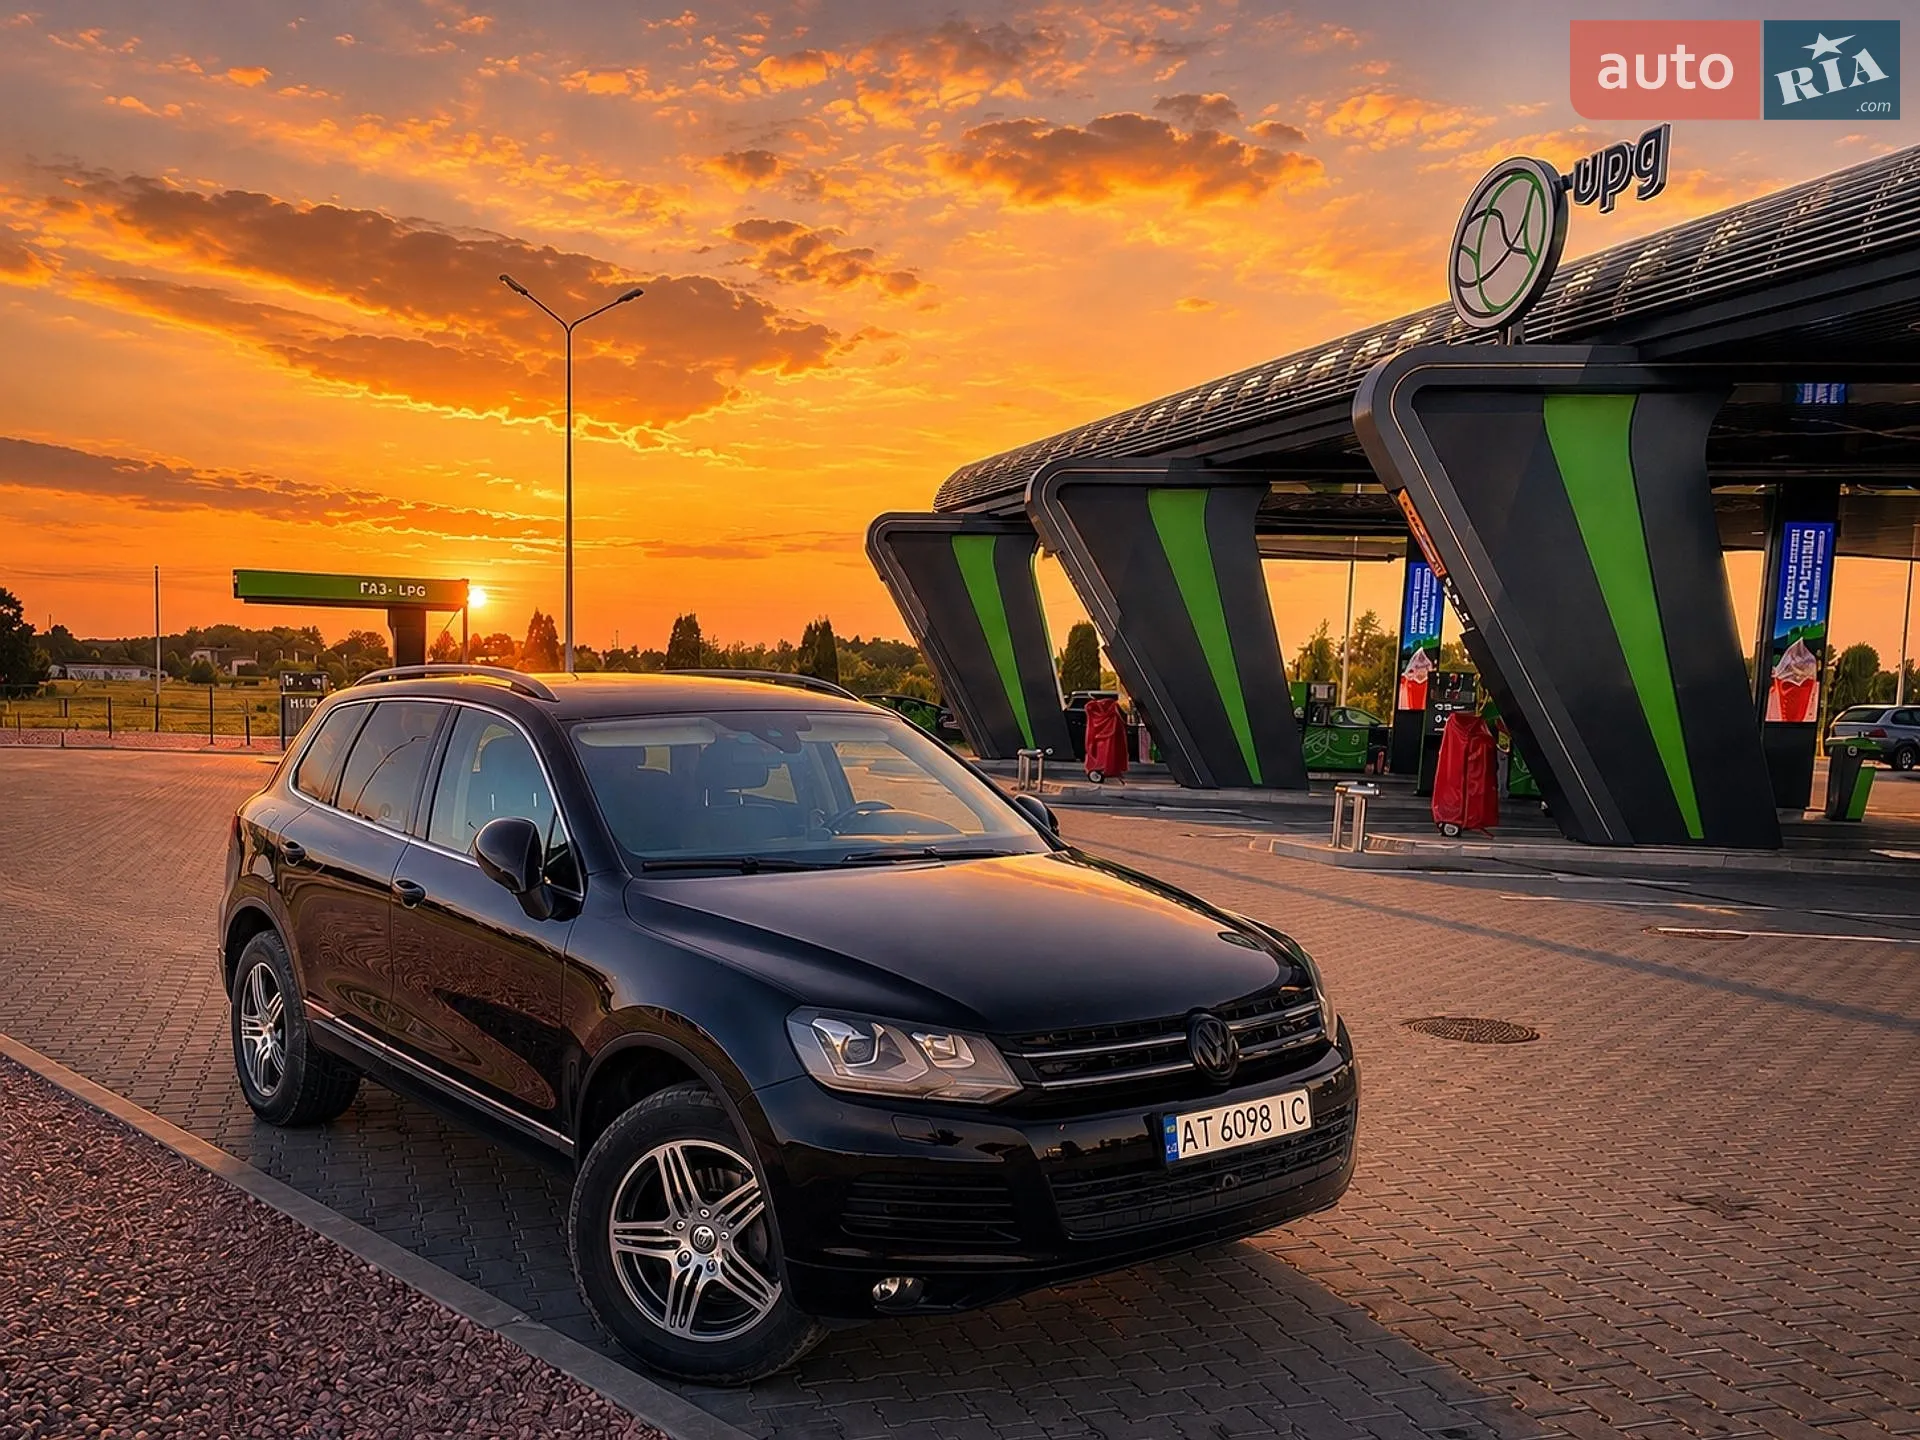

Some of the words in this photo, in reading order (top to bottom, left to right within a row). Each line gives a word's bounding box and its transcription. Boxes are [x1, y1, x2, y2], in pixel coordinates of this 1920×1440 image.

[1572, 122, 1671, 214] upg
[399, 585, 426, 597] LPG
[1181, 1116, 1213, 1153] AT
[1220, 1104, 1272, 1142] 6098
[1280, 1097, 1307, 1130] IC
